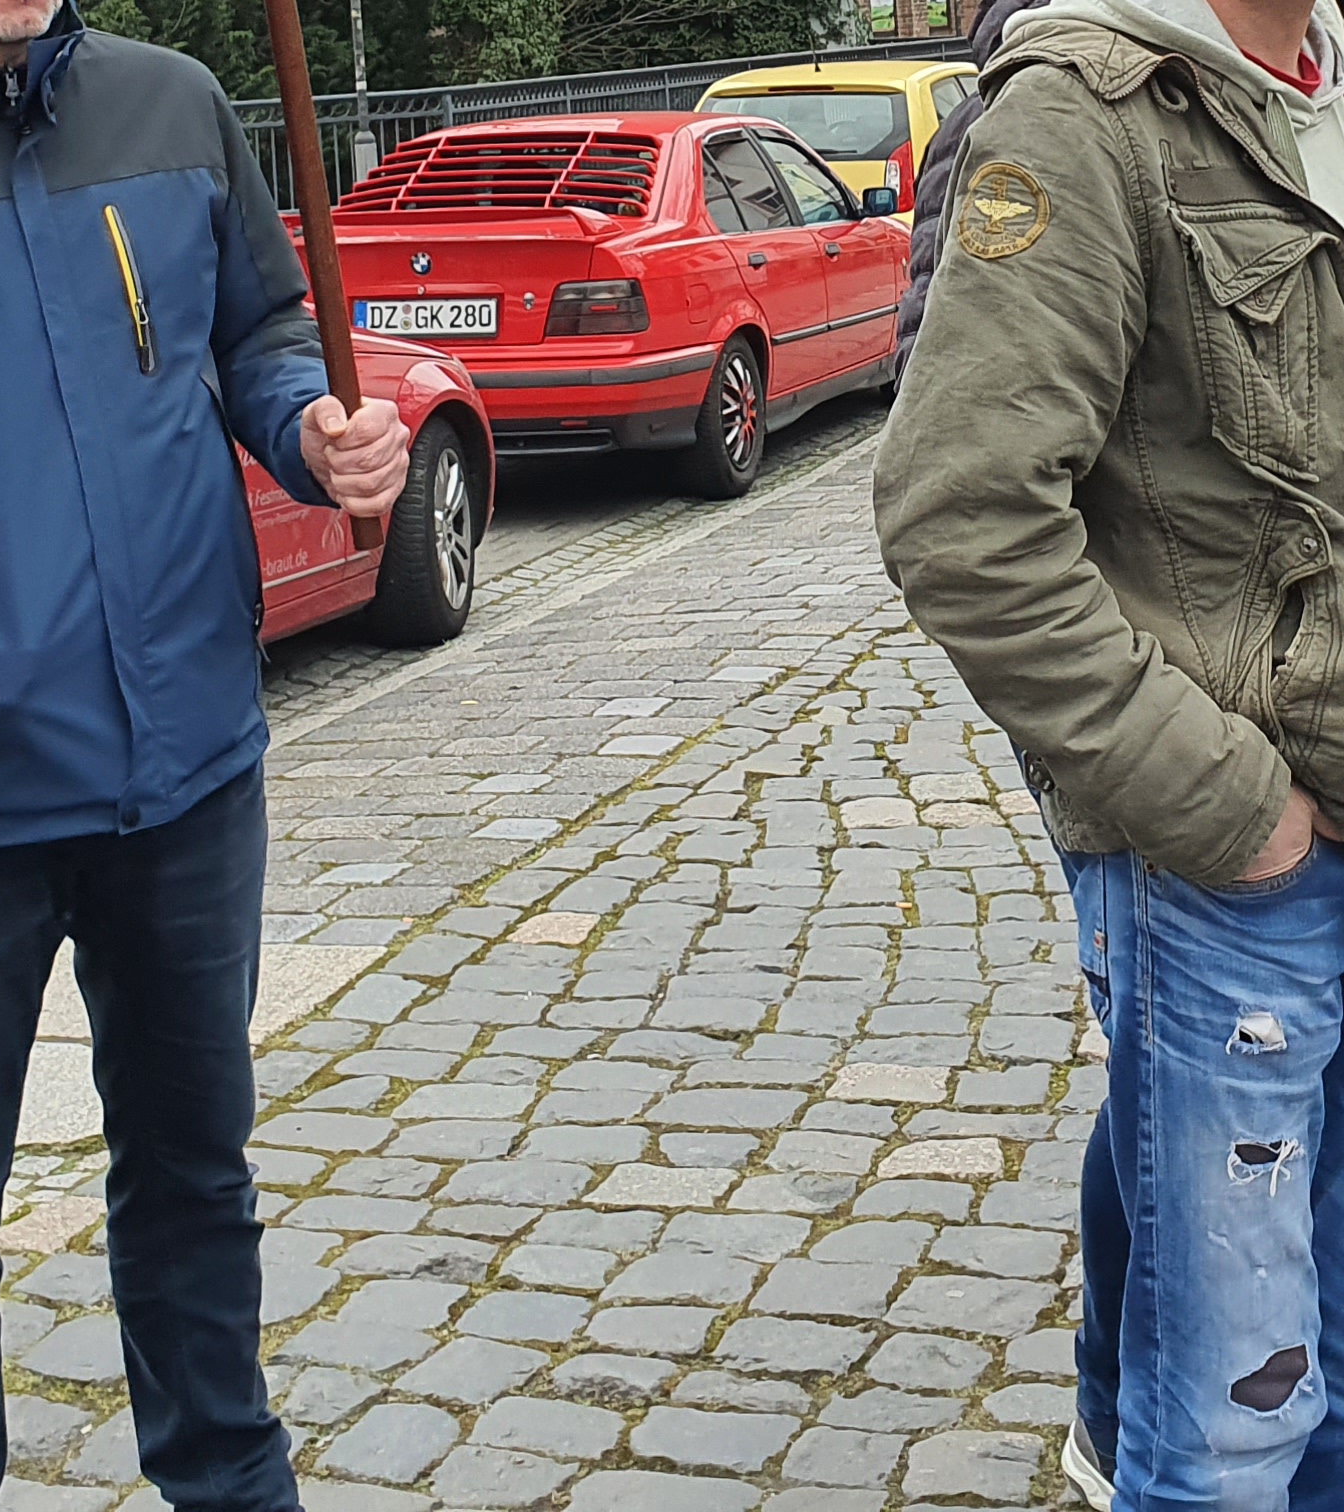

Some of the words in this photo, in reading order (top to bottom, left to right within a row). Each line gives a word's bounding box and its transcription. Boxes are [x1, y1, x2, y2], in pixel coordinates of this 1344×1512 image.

[369, 305, 398, 329] DZ
[415, 304, 444, 329] GK
[449, 303, 492, 328] 280
